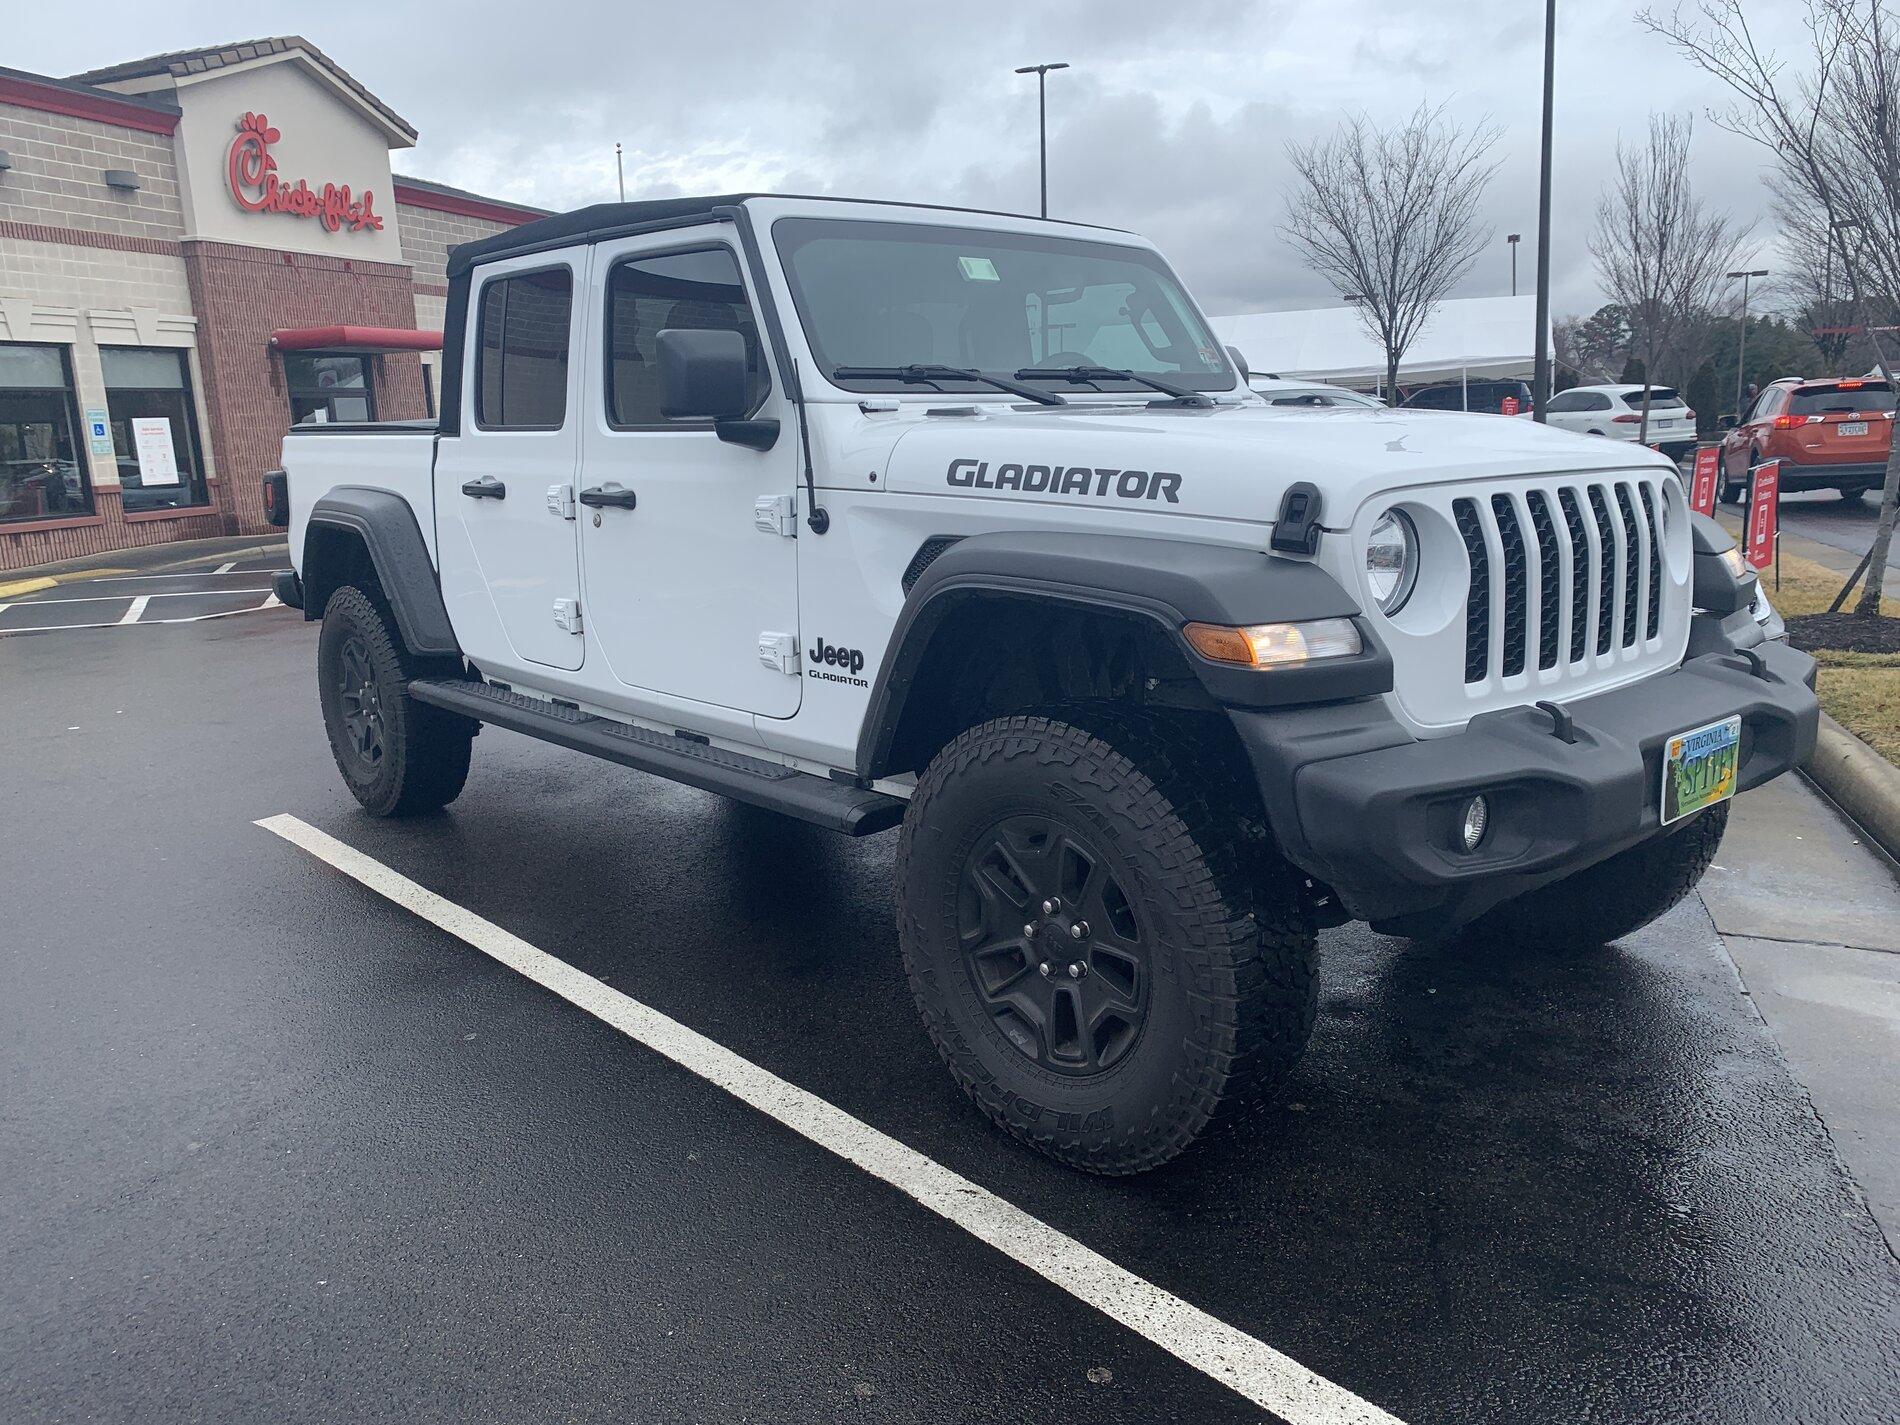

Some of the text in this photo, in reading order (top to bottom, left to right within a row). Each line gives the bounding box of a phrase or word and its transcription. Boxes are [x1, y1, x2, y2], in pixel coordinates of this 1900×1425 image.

[229, 128, 384, 232] Chick-fil-A
[946, 458, 1183, 504] GLADIATOR
[809, 637, 864, 675] Jeep
[809, 670, 869, 688] GLADIATOR
[1686, 729, 1723, 752] VIRGINIA
